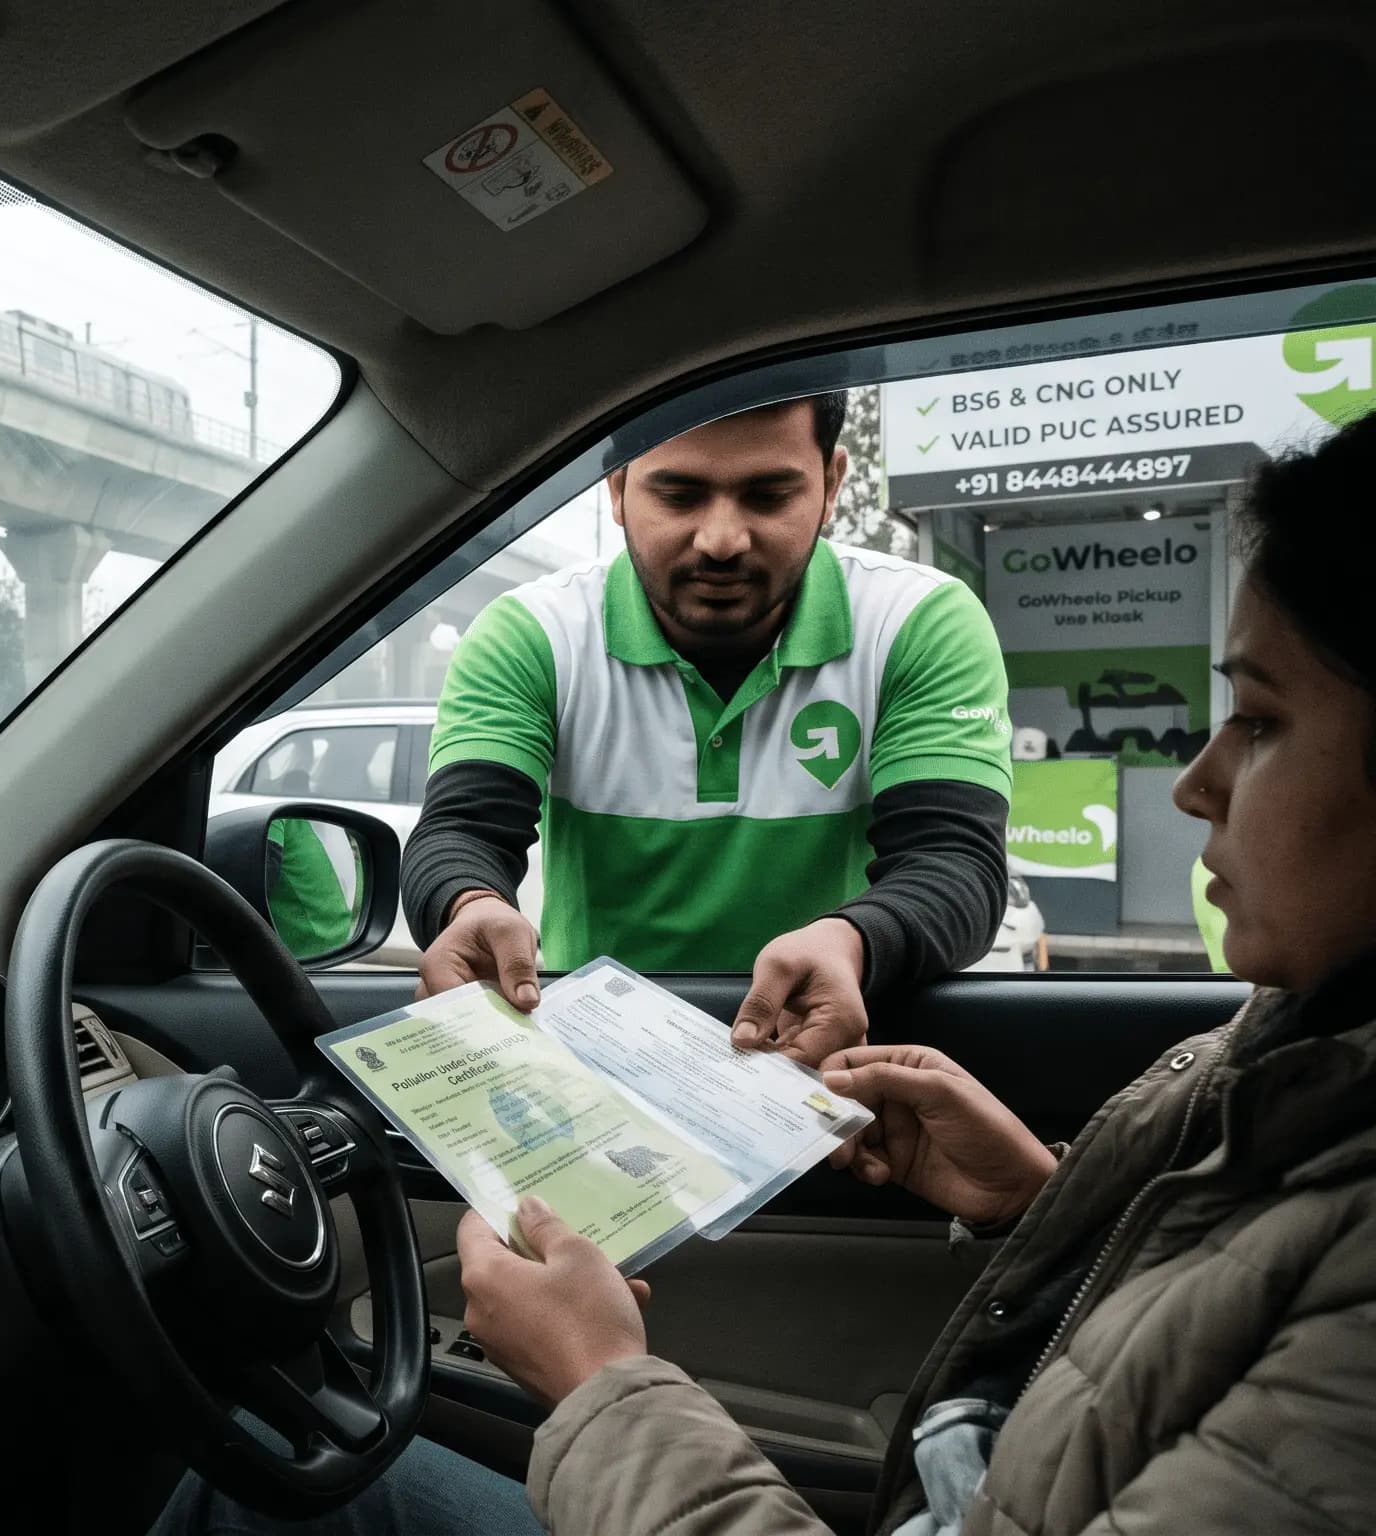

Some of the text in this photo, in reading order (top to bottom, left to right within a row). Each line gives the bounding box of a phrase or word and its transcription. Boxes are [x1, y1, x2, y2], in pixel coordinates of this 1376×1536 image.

[952, 369, 1182, 413] BS6 & CNG ONLY
[951, 404, 1245, 451] VALID PUC ASSURED
[955, 454, 1191, 496] +91 8448444897
[1003, 538, 1197, 574] GoWheelo
[1117, 588, 1182, 603] Pickup
[1092, 609, 1144, 625] Kiosk
